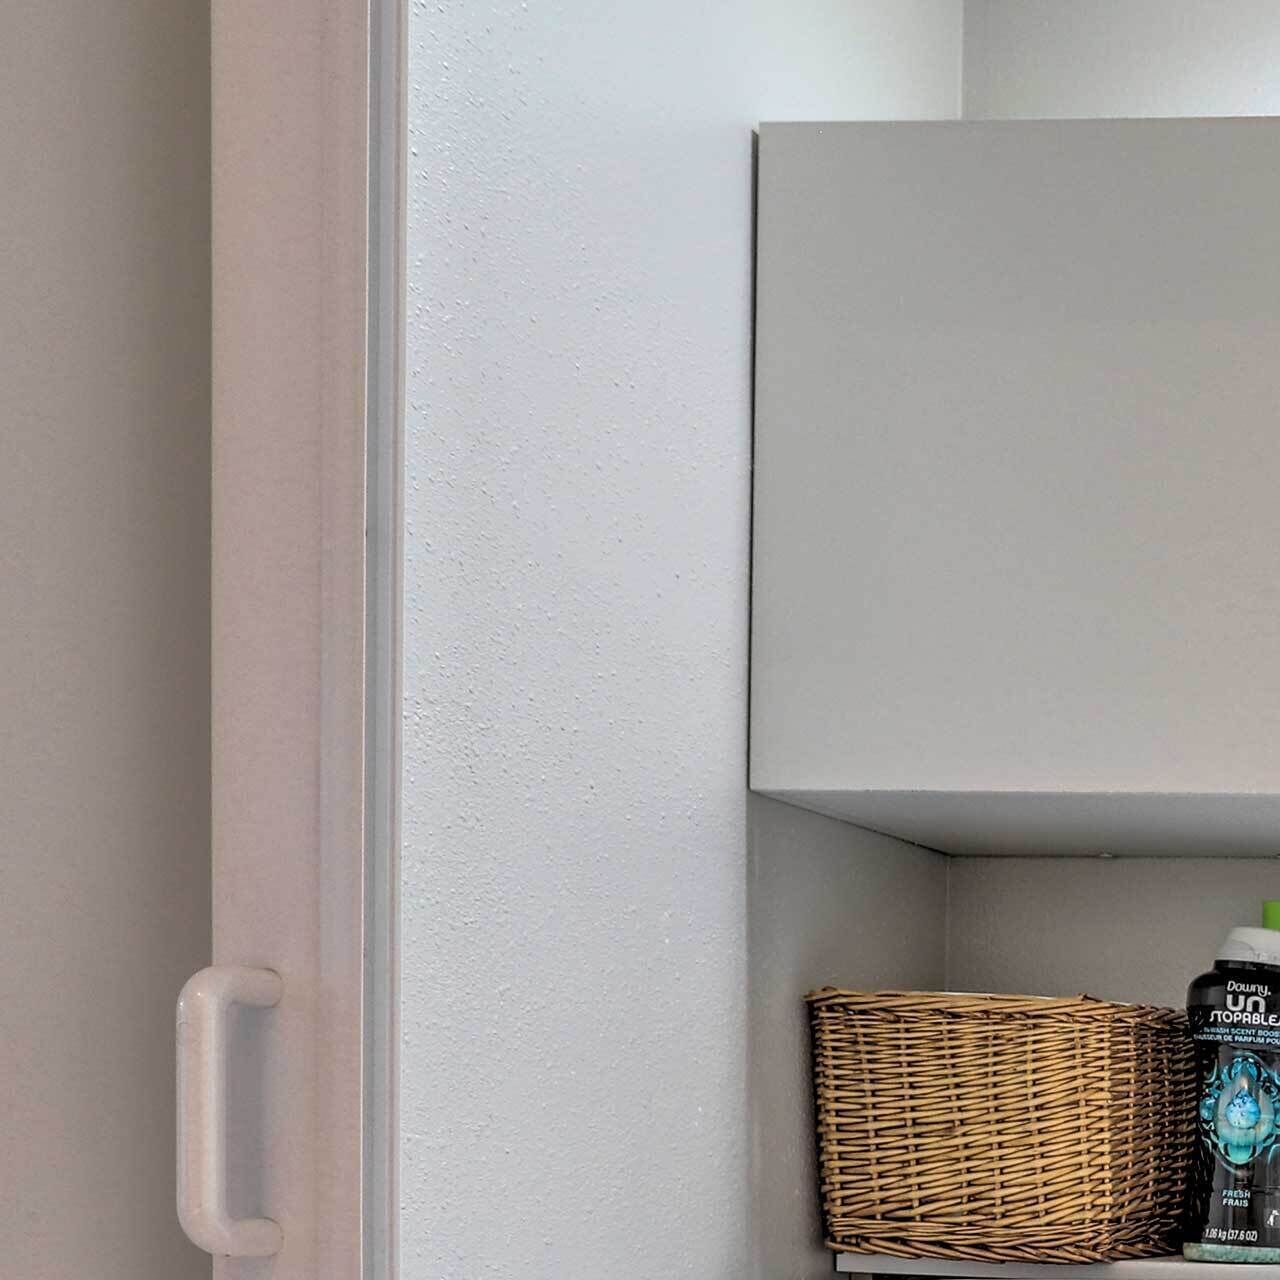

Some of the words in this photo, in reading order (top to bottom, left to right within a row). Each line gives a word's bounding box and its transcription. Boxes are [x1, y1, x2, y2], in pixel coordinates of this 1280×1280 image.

[1231, 1027, 1255, 1037] SCENT
[1222, 1189, 1251, 1199] FRESH
[1222, 1199, 1249, 1208] FRAIS
